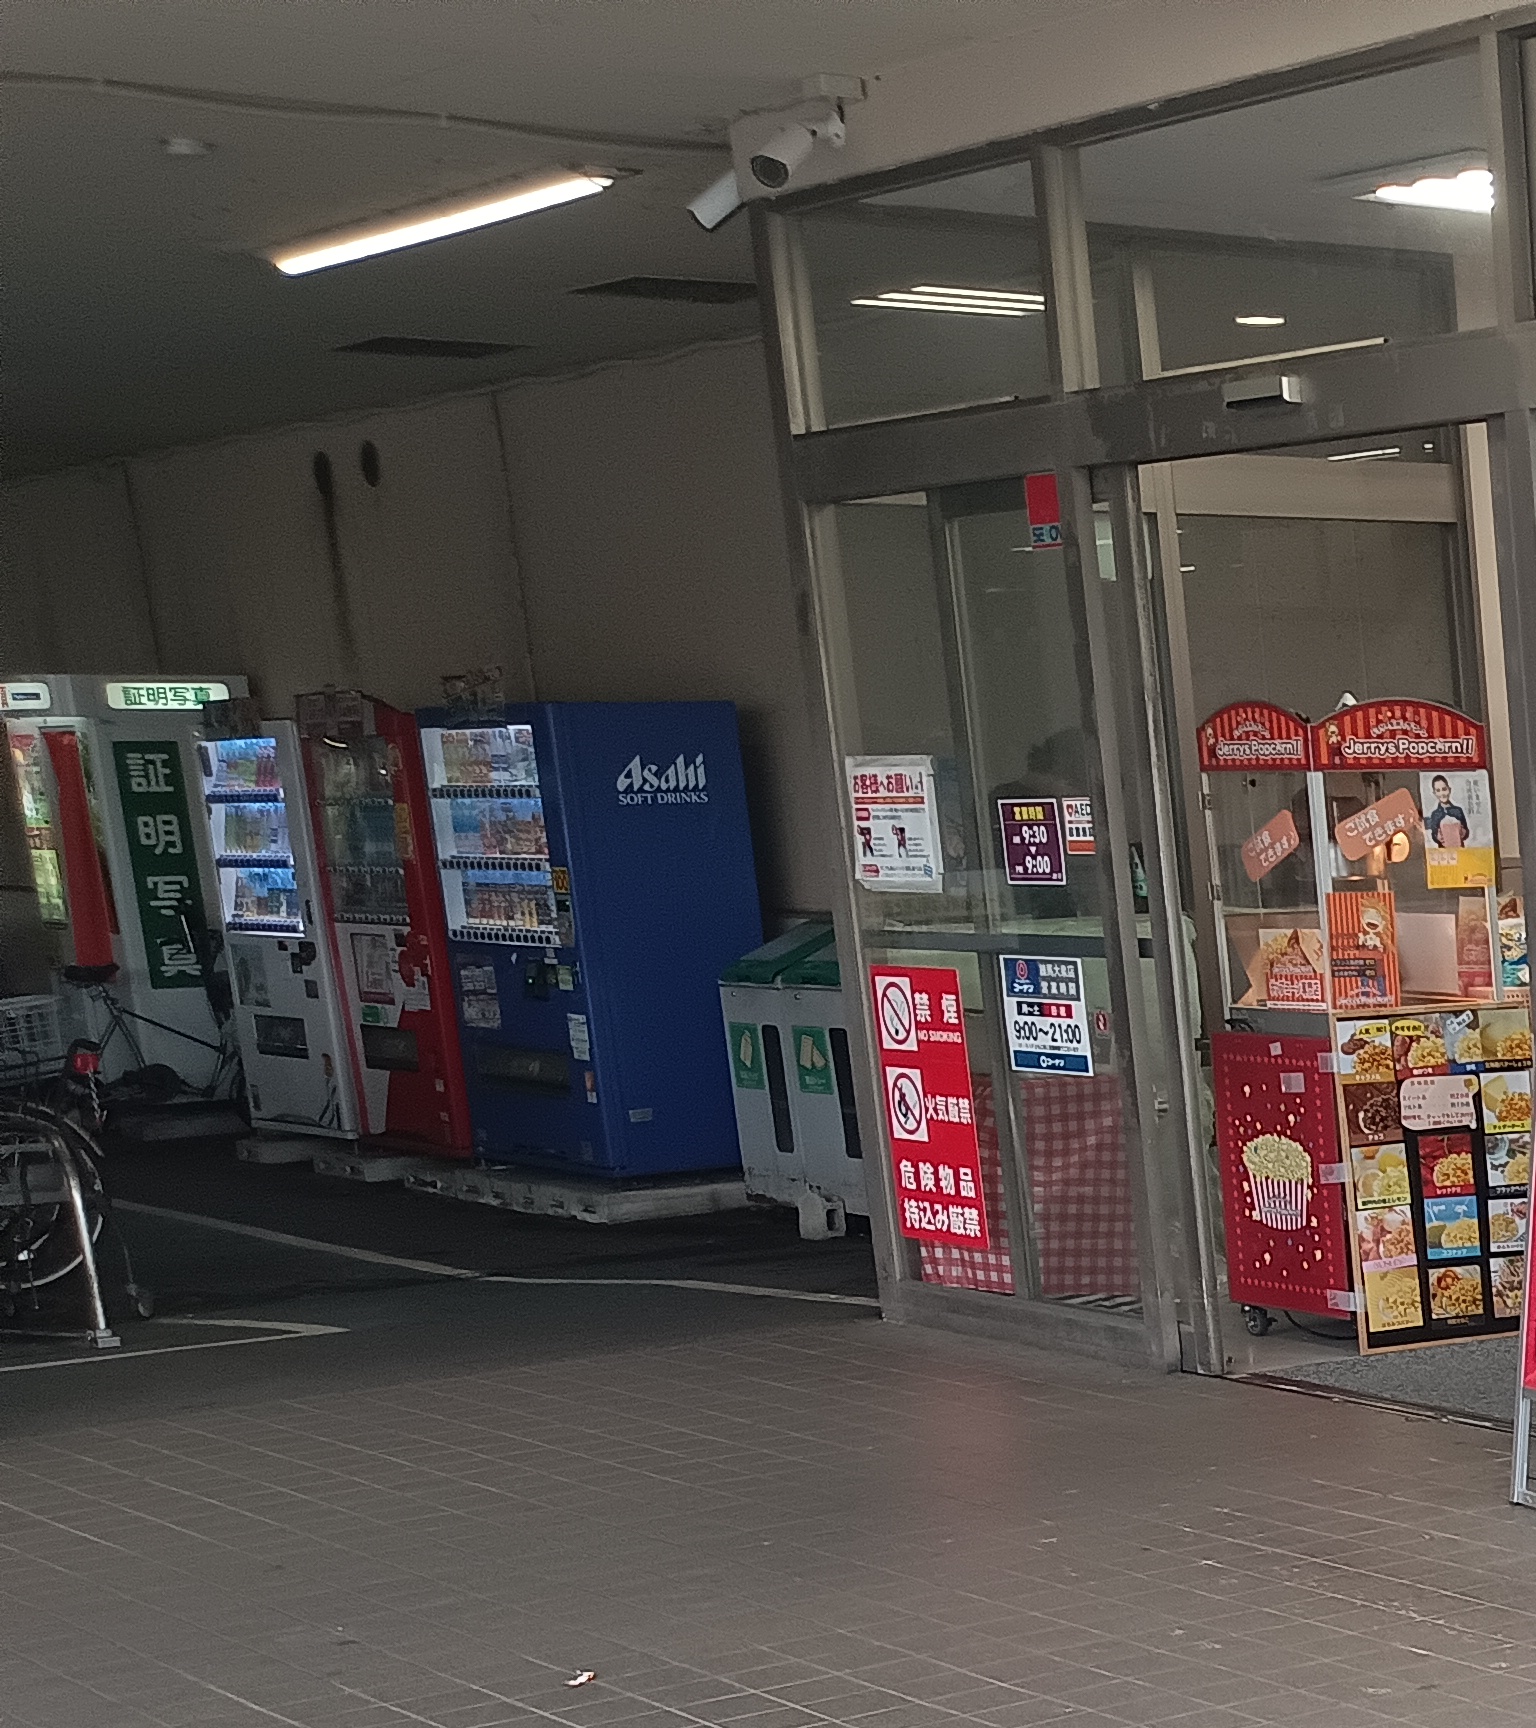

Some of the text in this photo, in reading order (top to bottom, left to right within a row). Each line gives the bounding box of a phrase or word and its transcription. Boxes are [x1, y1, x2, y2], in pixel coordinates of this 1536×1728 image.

[121, 686, 212, 706] 証明写真
[1342, 737, 1474, 758] Jerrys Popcorn!!
[616, 752, 707, 792] Asahi
[618, 791, 709, 806] SOFT DRINKS
[1021, 825, 1048, 844] 9:30
[1025, 855, 1051, 874] 9:00
[917, 1029, 962, 1044] NO SMOKING
[925, 1094, 972, 1125] 火気厳禁
[900, 1159, 977, 1199] 危険物品
[904, 1198, 981, 1238] 持込み厳禁
